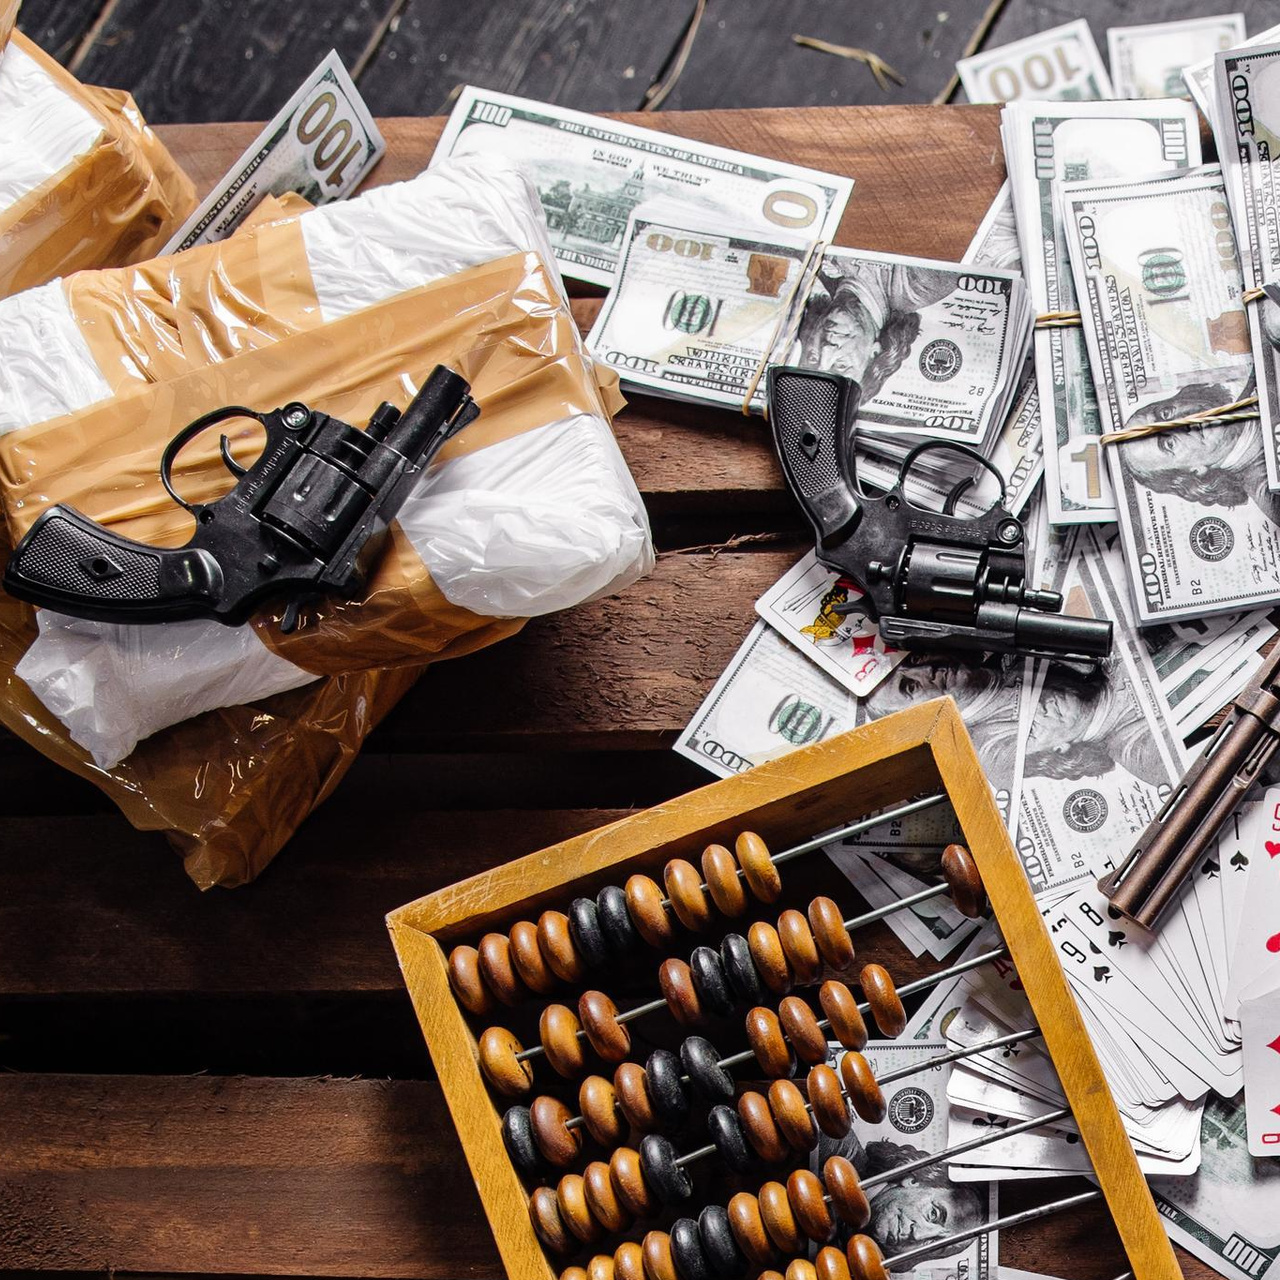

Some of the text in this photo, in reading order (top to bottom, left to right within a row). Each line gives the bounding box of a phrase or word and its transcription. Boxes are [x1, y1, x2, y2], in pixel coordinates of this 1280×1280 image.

[470, 102, 513, 127] 100
[1231, 73, 1254, 136] 100
[296, 91, 362, 188] 100
[643, 233, 715, 261] 100
[1077, 215, 1103, 270] 100
[956, 274, 1007, 296] 100
[966, 384, 984, 397] B2
[924, 408, 977, 433] 100
[1139, 551, 1164, 609] 100
[1189, 577, 1203, 595] B2
[1070, 851, 1085, 869] B2
[1078, 901, 1105, 927] 8
[1060, 940, 1087, 964] 9
